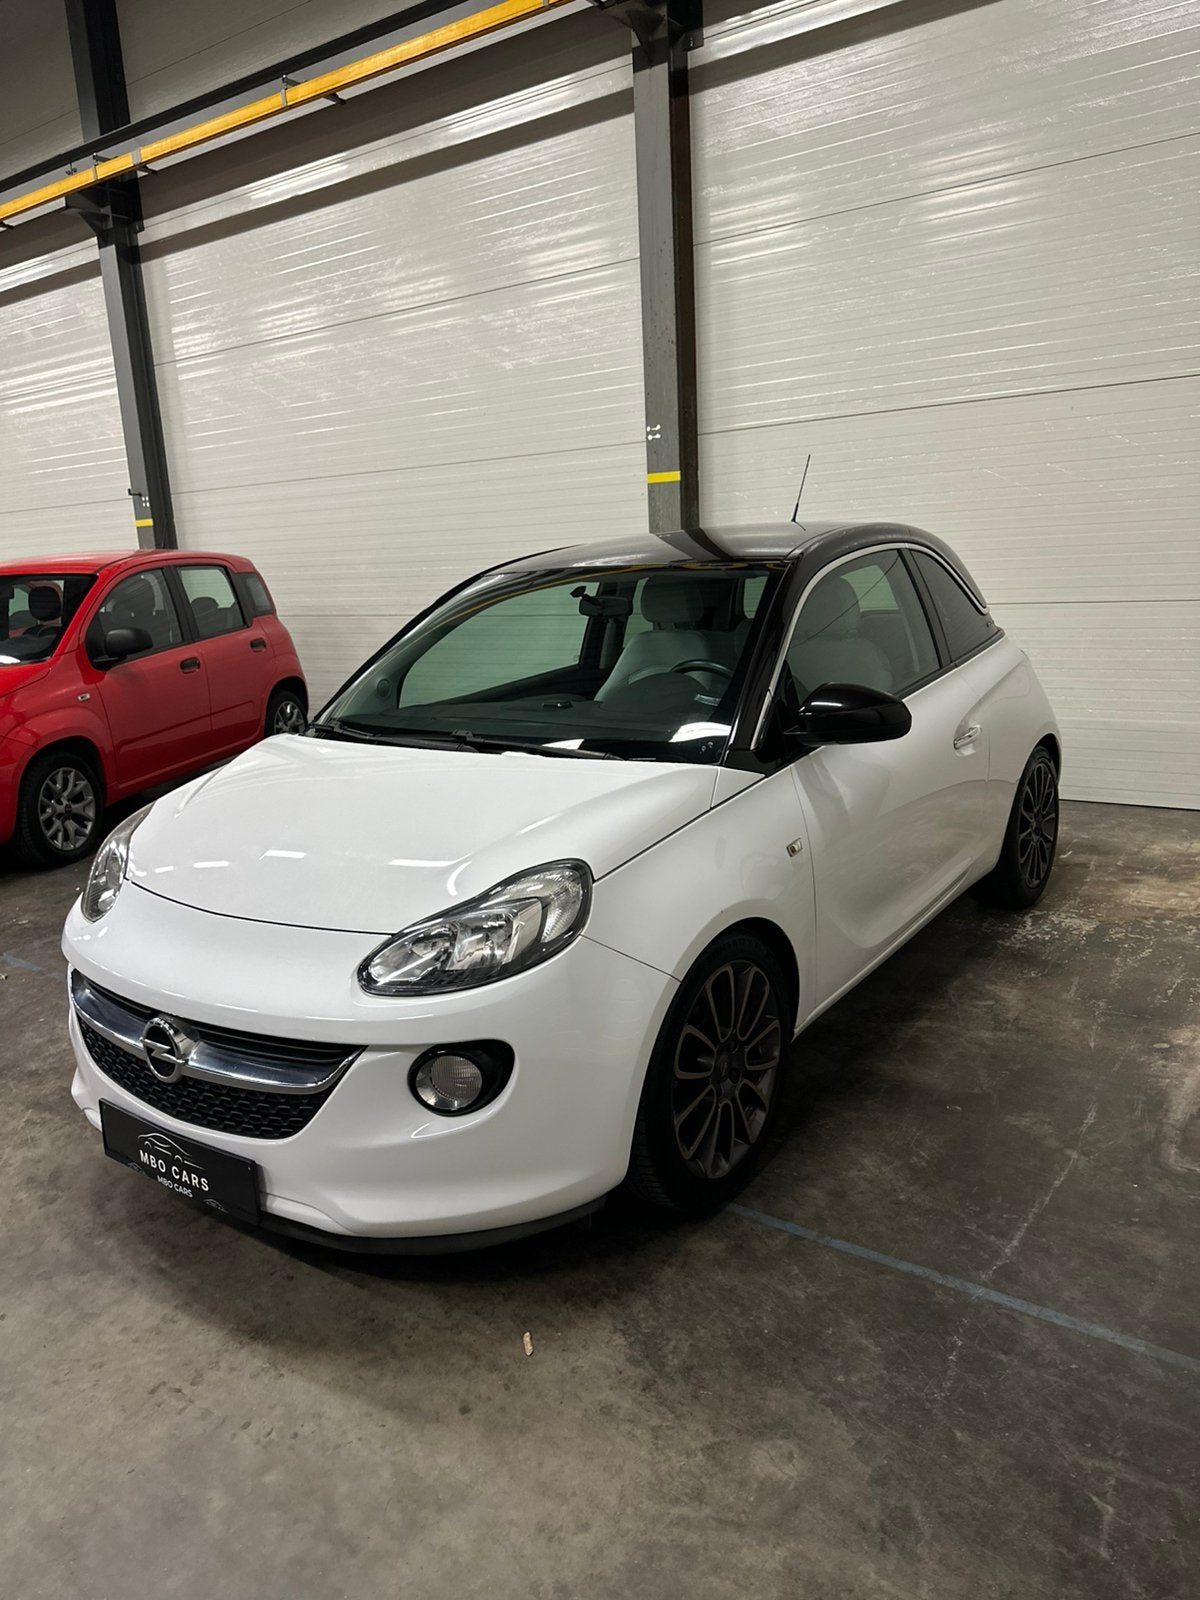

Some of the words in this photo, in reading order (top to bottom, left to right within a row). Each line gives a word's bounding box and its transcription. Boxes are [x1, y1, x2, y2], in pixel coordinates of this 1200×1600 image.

[139, 1149, 165, 1172] MBO
[172, 1166, 209, 1191] CARS
[157, 1175, 173, 1188] MBO
[174, 1183, 193, 1197] CARS
